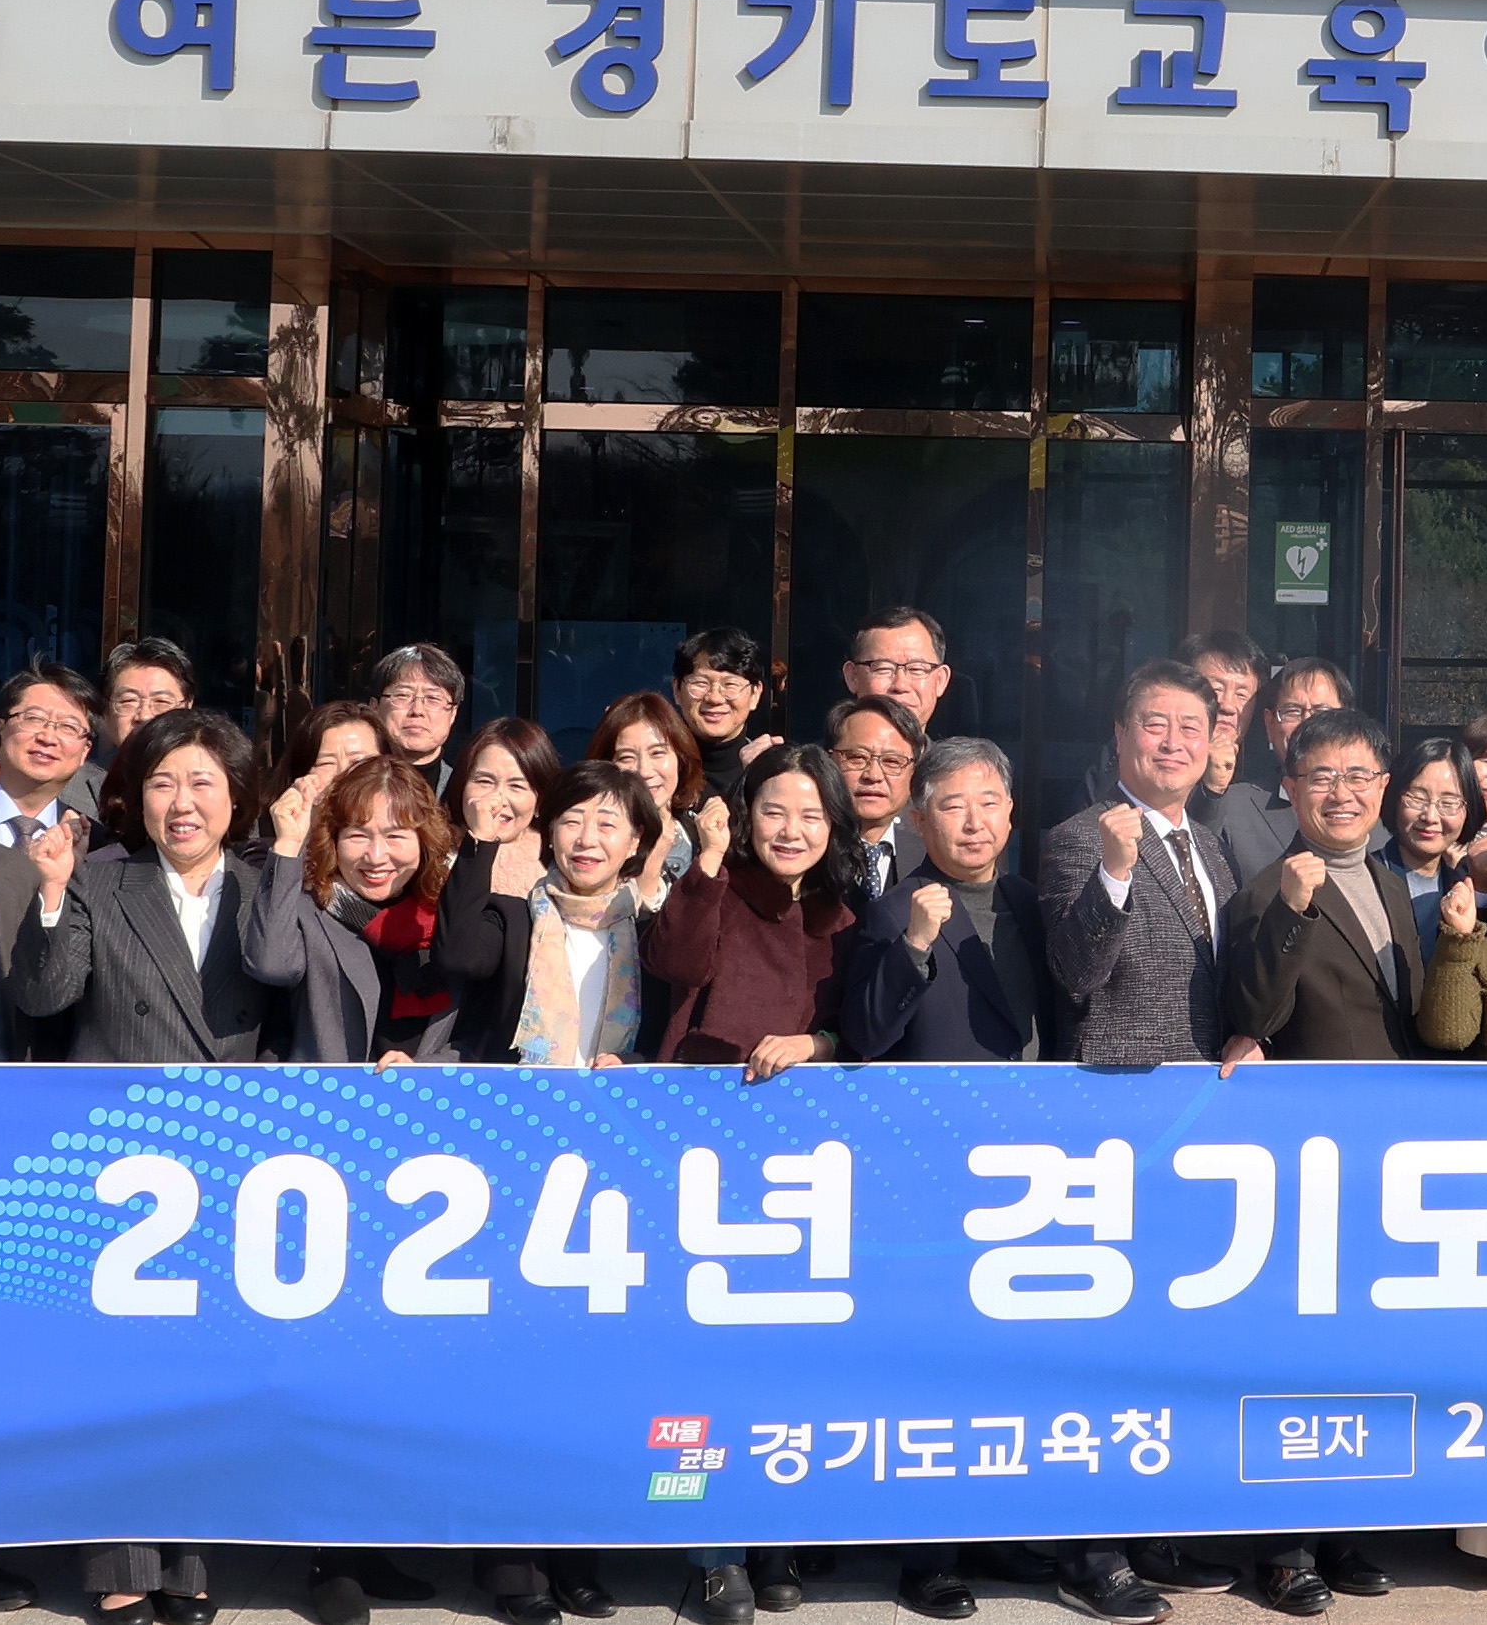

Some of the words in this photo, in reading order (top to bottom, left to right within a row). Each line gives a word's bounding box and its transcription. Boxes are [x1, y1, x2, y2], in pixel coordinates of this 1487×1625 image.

[1280, 525, 1295, 533] AED
[92, 1139, 854, 1324] 2024년
[655, 1420, 703, 1444] 자율
[1278, 1413, 1369, 1460] 일자
[749, 1407, 1171, 1485] 경기도교육청
[678, 1447, 725, 1471] 균형
[655, 1474, 702, 1498] 미래
